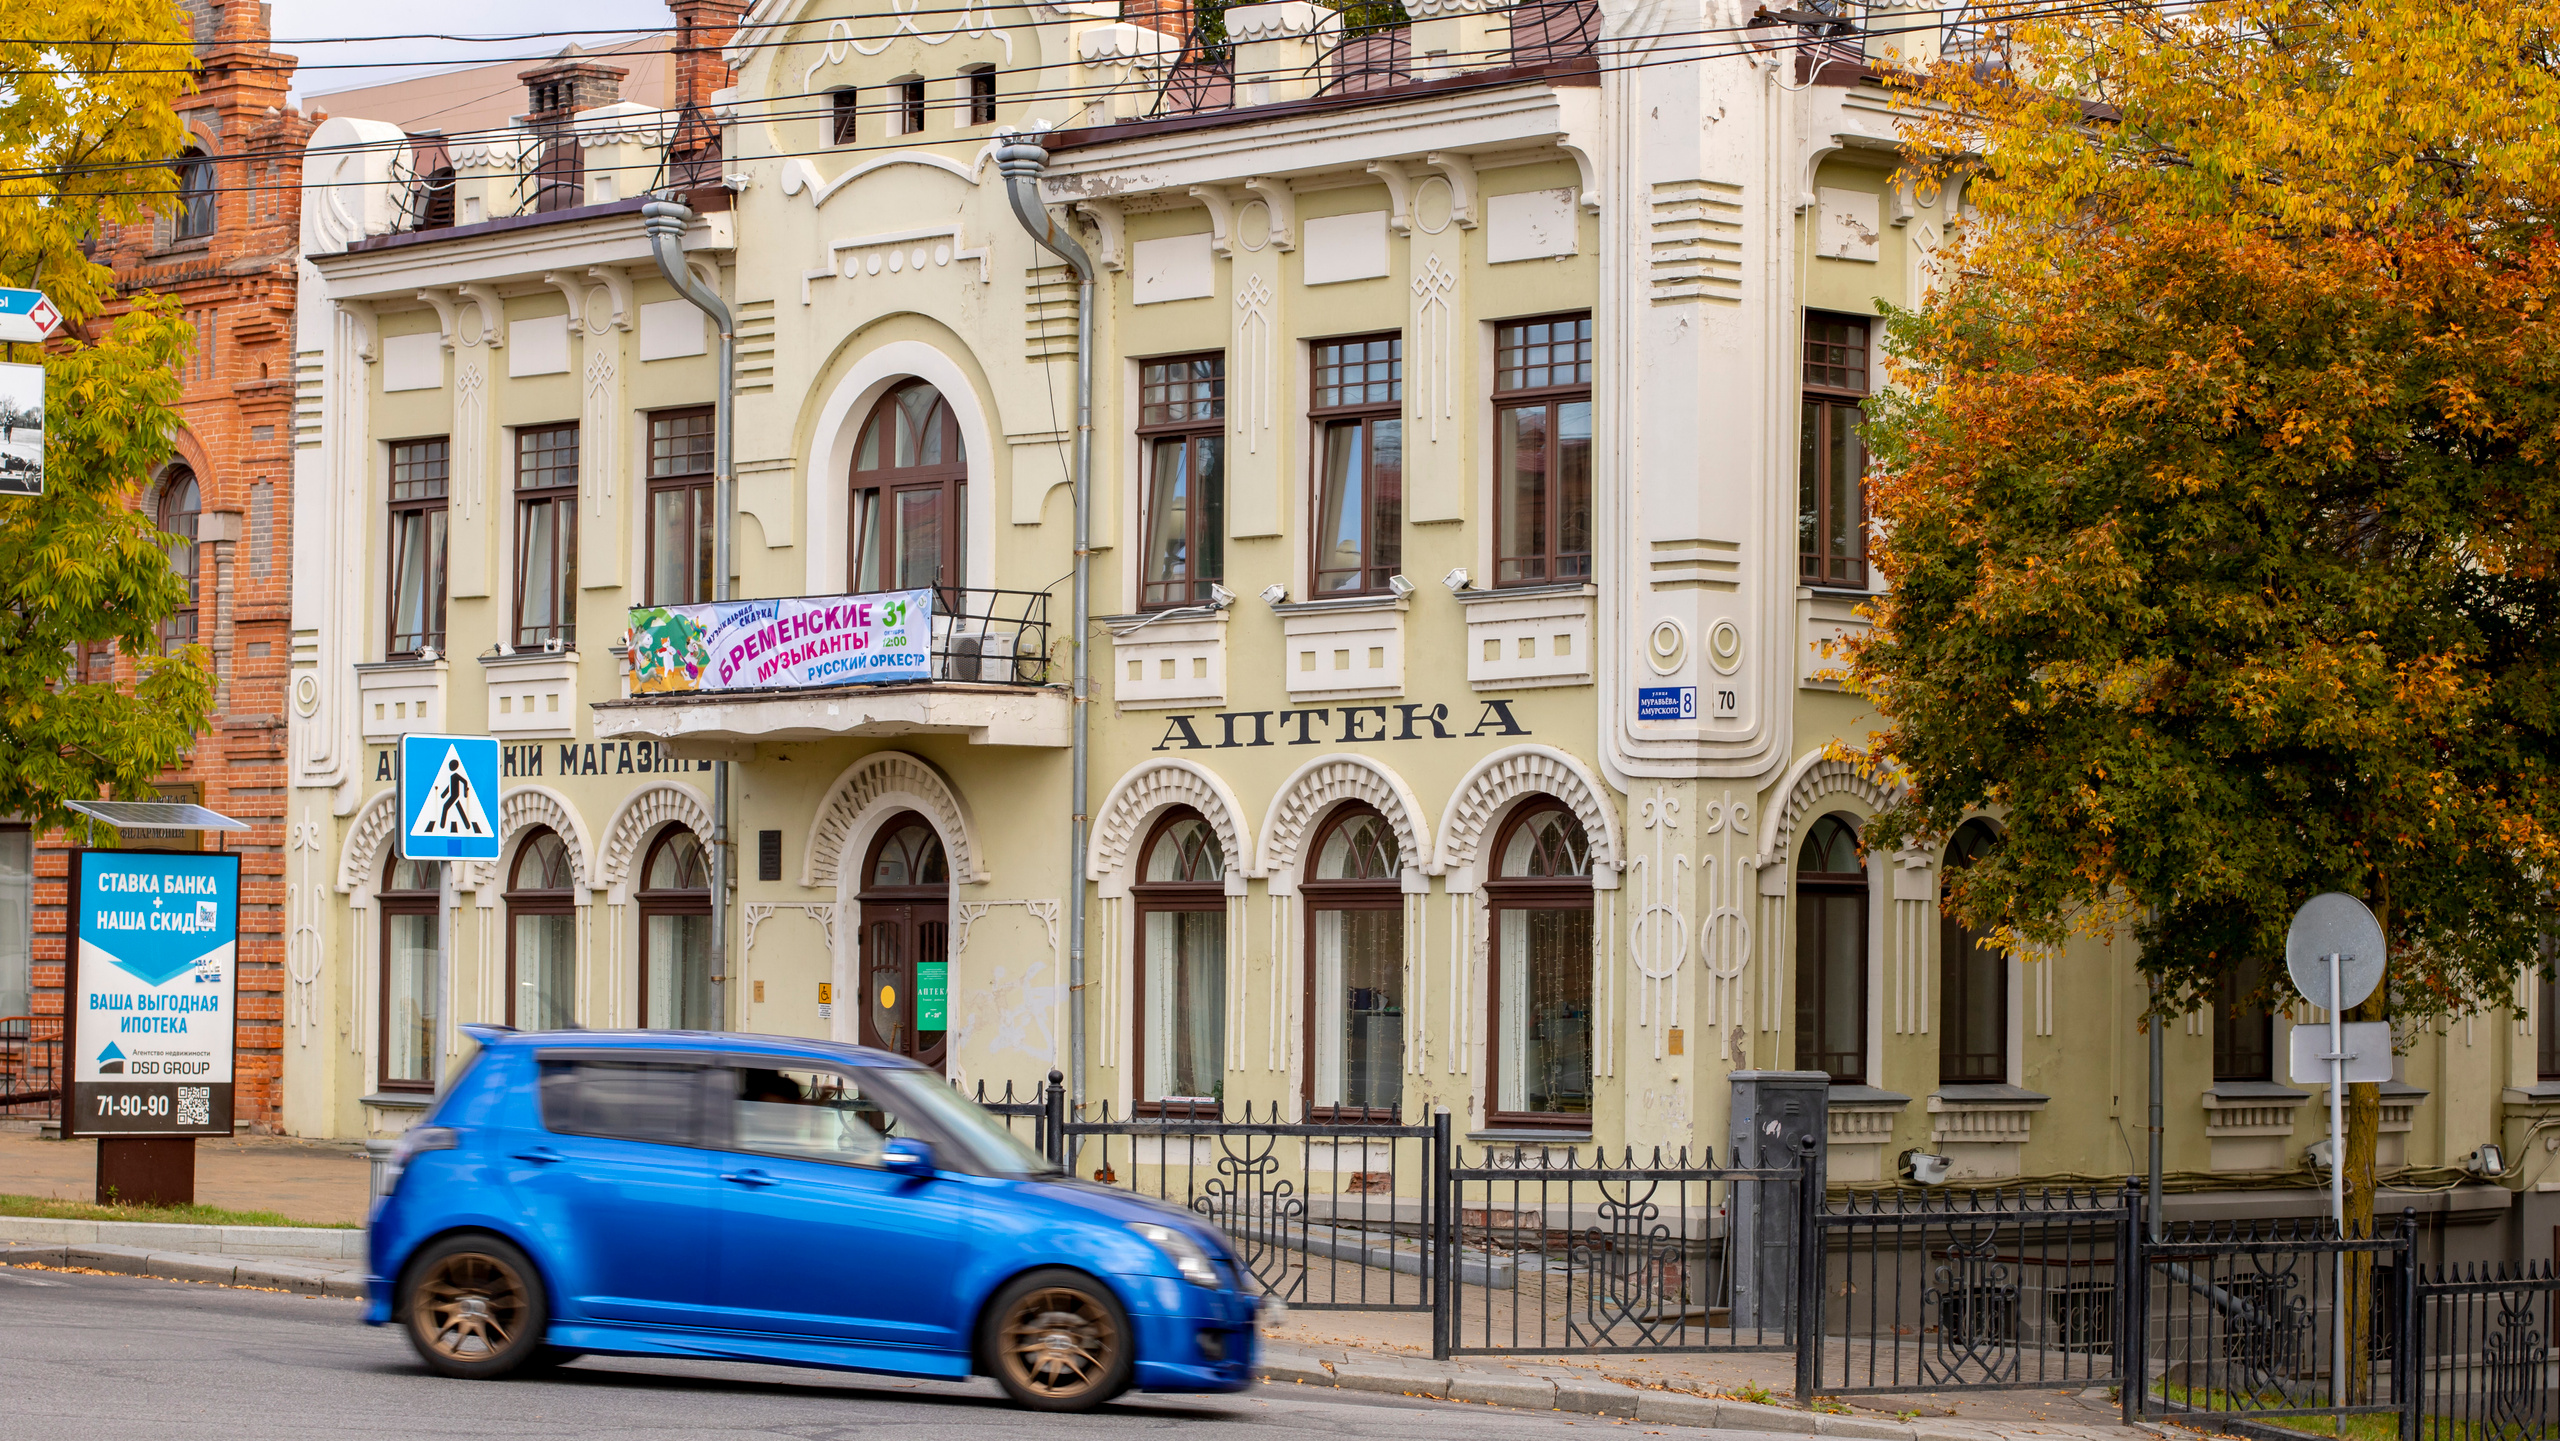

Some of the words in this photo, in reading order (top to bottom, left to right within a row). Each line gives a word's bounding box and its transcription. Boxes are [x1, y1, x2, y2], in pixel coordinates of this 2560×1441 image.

[739, 607, 773, 627] СКАЗКА
[882, 599, 907, 628] 31
[706, 604, 753, 646] МУЗЫКАЛЬНАЯ
[718, 603, 873, 687] БРЕМЕНСКИЕ
[882, 636, 907, 648] 12:00
[757, 631, 869, 684] МУЗЫКАНТЫ
[808, 652, 867, 681] РУССКИЙ
[869, 653, 925, 668] ОРКЕСТР
[1641, 707, 1679, 716] АМУРСКОГО
[1684, 693, 1692, 713] 8
[1718, 691, 1735, 710] 70
[1151, 699, 1533, 751] АПТЕКА
[98, 872, 160, 894] СТАВКА
[164, 874, 218, 895] БАНКА
[96, 910, 147, 931] НАША
[149, 911, 217, 935] СКИД
[89, 993, 134, 1011] ВАША
[137, 994, 219, 1014] ВЫГОДНАЯ
[120, 1016, 188, 1034] ИПОТЕКА
[132, 1048, 164, 1057] Агентство
[165, 1049, 211, 1058] недвижимости
[131, 1061, 160, 1075] DSD
[163, 1061, 211, 1075] GROUP
[96, 1094, 169, 1117] 71-90-90
